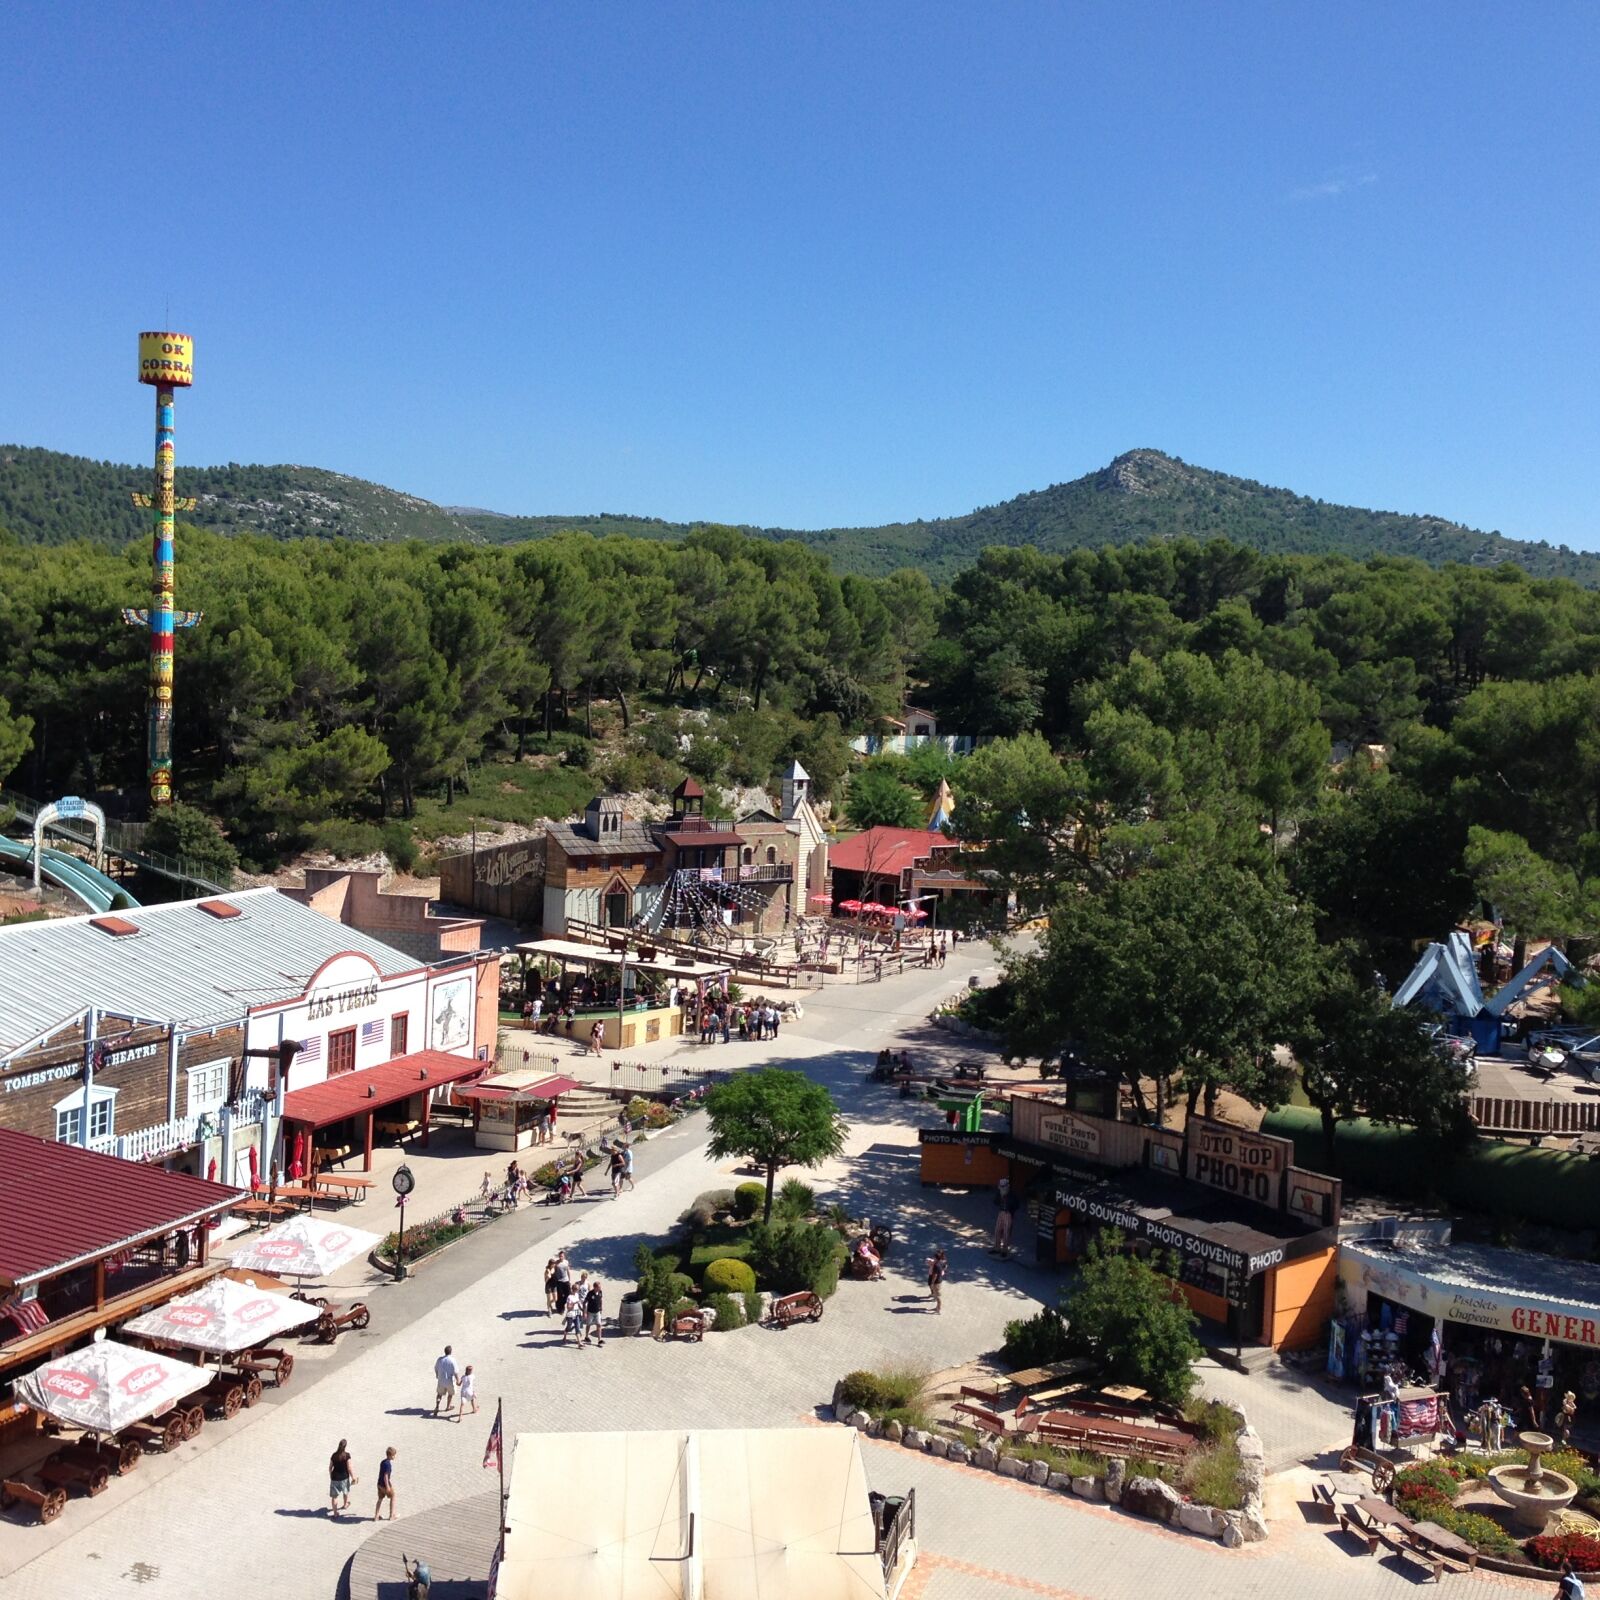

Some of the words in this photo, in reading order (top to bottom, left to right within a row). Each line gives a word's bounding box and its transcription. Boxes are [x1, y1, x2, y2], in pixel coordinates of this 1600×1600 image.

[162, 343, 184, 355] OK
[142, 358, 192, 374] CORRA
[307, 994, 334, 1021] LAS
[338, 984, 378, 1013] VEGAS
[4, 1063, 79, 1093] TOMBSTONE
[104, 1043, 157, 1067] THEATRE
[923, 1134, 950, 1144] PHOTO
[962, 1137, 990, 1145] MATIN
[1044, 1120, 1068, 1134] VOTRE
[1071, 1127, 1096, 1142] PHOTO
[1048, 1131, 1089, 1150] SOUVENIR
[1196, 1153, 1269, 1201] PHOTO
[1056, 1190, 1087, 1212] PHOTO
[1089, 1203, 1139, 1231] SOUVENIR
[1146, 1222, 1182, 1247] PHOTO
[1185, 1237, 1243, 1269] SOUVENIR
[1250, 1248, 1283, 1272] PHOTO
[1453, 1294, 1498, 1311] Pistolets
[1449, 1307, 1500, 1326] Chapeaux
[1511, 1307, 1600, 1344] GENER
